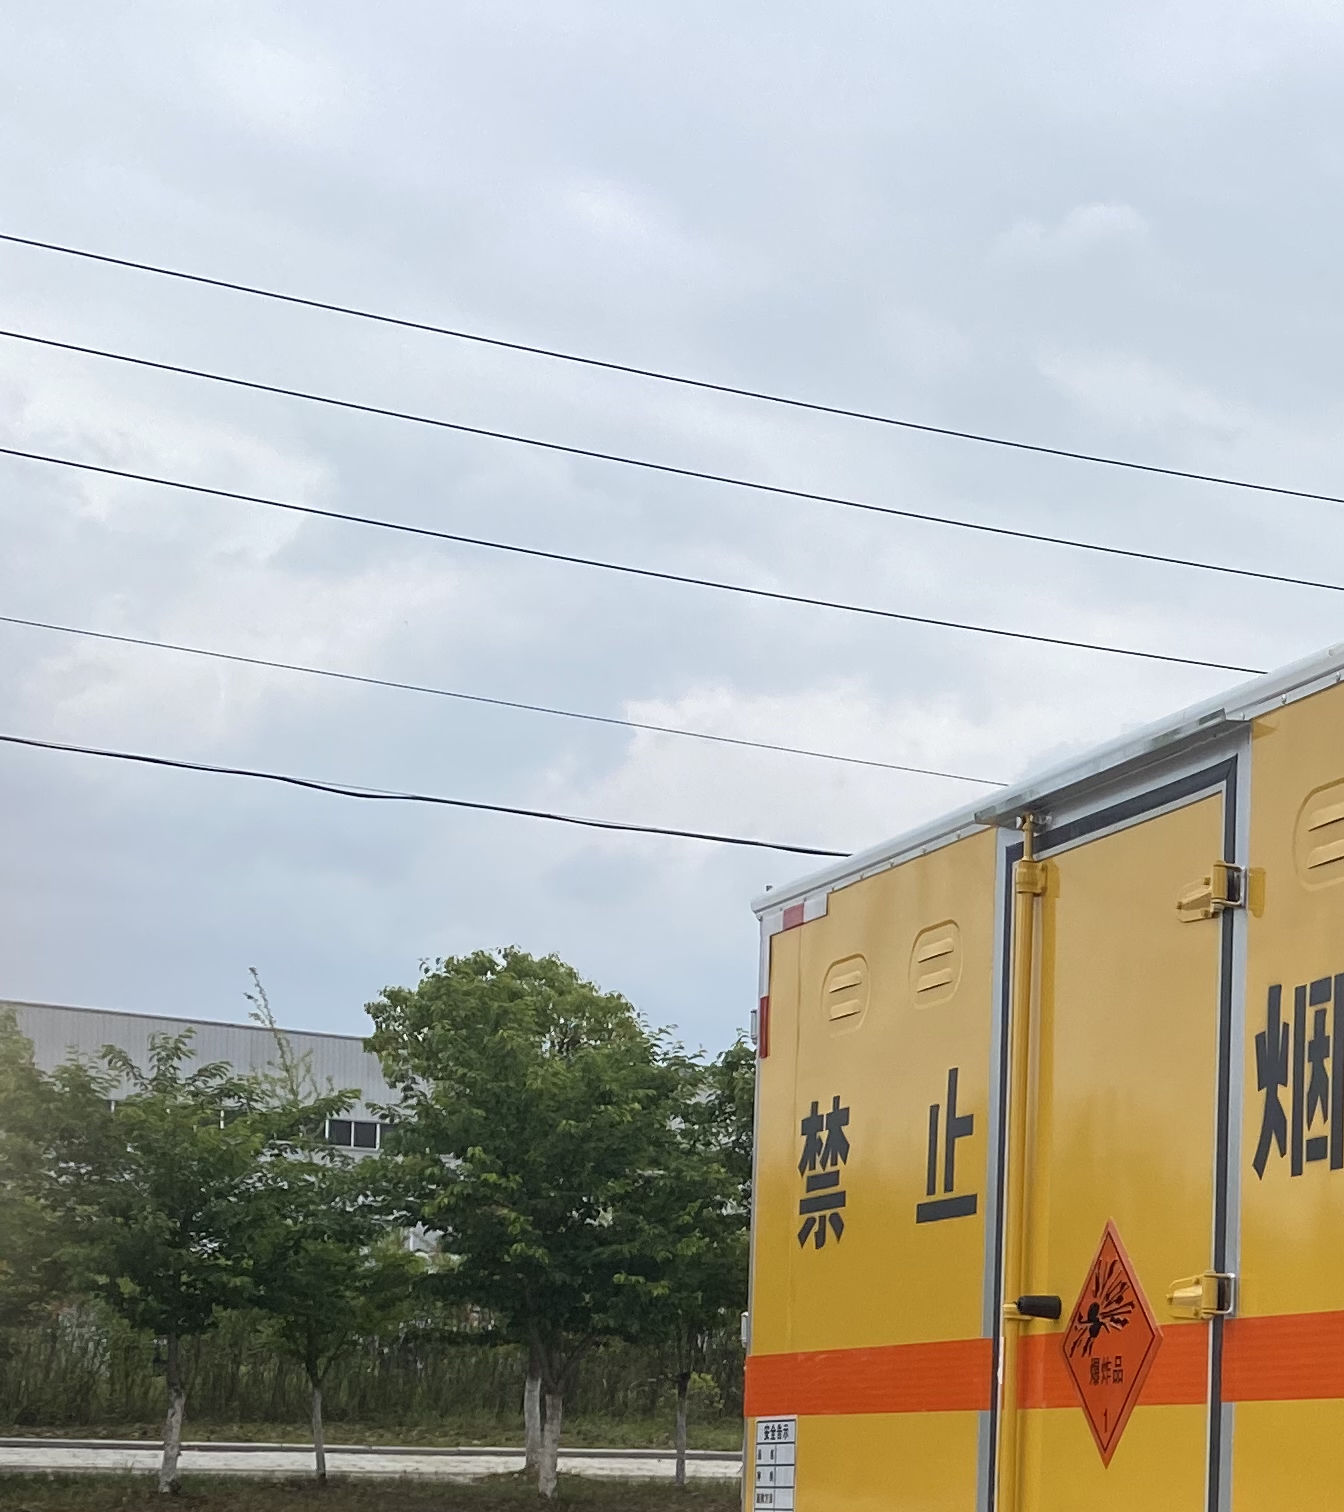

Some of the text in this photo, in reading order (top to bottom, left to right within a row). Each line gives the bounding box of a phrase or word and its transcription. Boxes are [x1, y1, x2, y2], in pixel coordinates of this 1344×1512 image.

[1089, 1356, 1123, 1386] 爆炸品
[1103, 1408, 1108, 1433] 1
